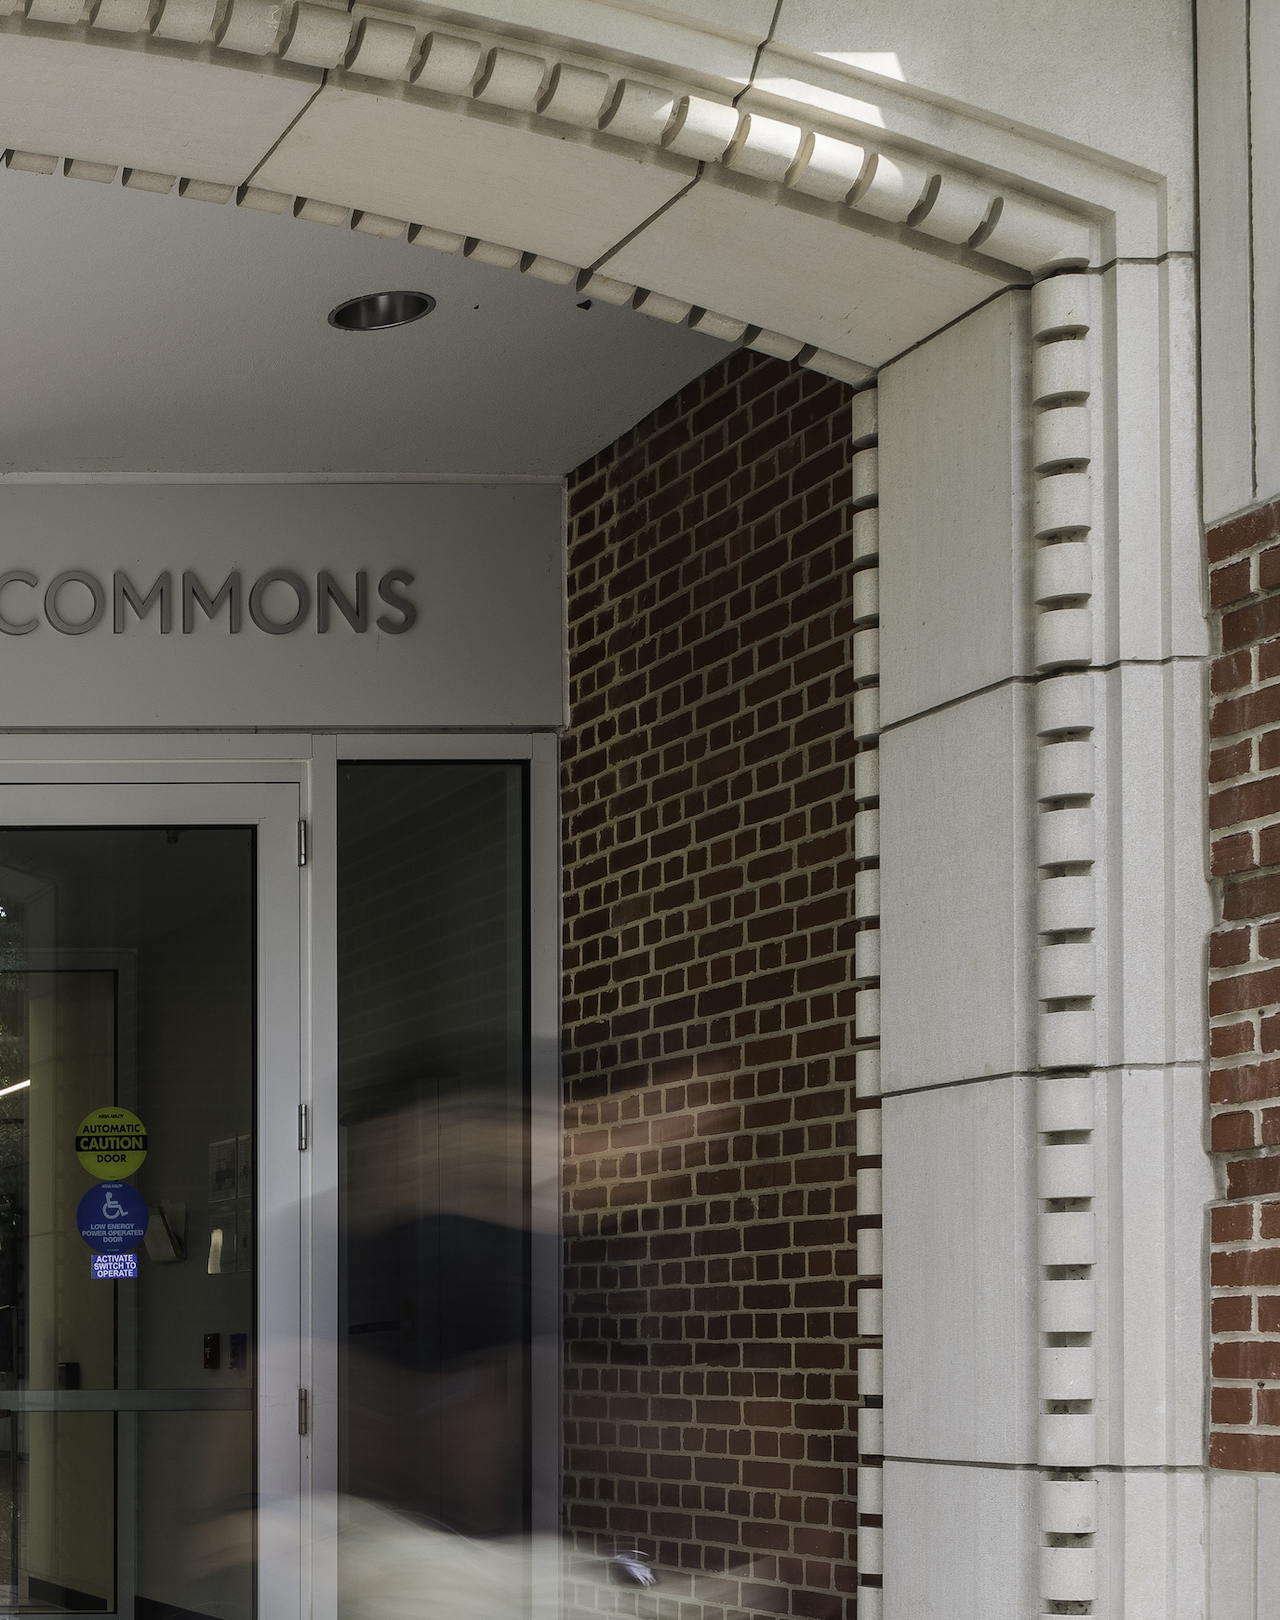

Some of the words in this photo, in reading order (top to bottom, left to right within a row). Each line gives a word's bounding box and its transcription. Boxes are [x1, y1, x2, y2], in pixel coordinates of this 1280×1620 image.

[83, 1124, 140, 1133] AUTOMATIC
[79, 1136, 143, 1150] CAUTION
[97, 1154, 127, 1163] DOOR
[96, 1254, 133, 1262] ACTIVATE
[94, 1262, 124, 1270] SWITCH
[97, 1269, 134, 1277] OPERATE
